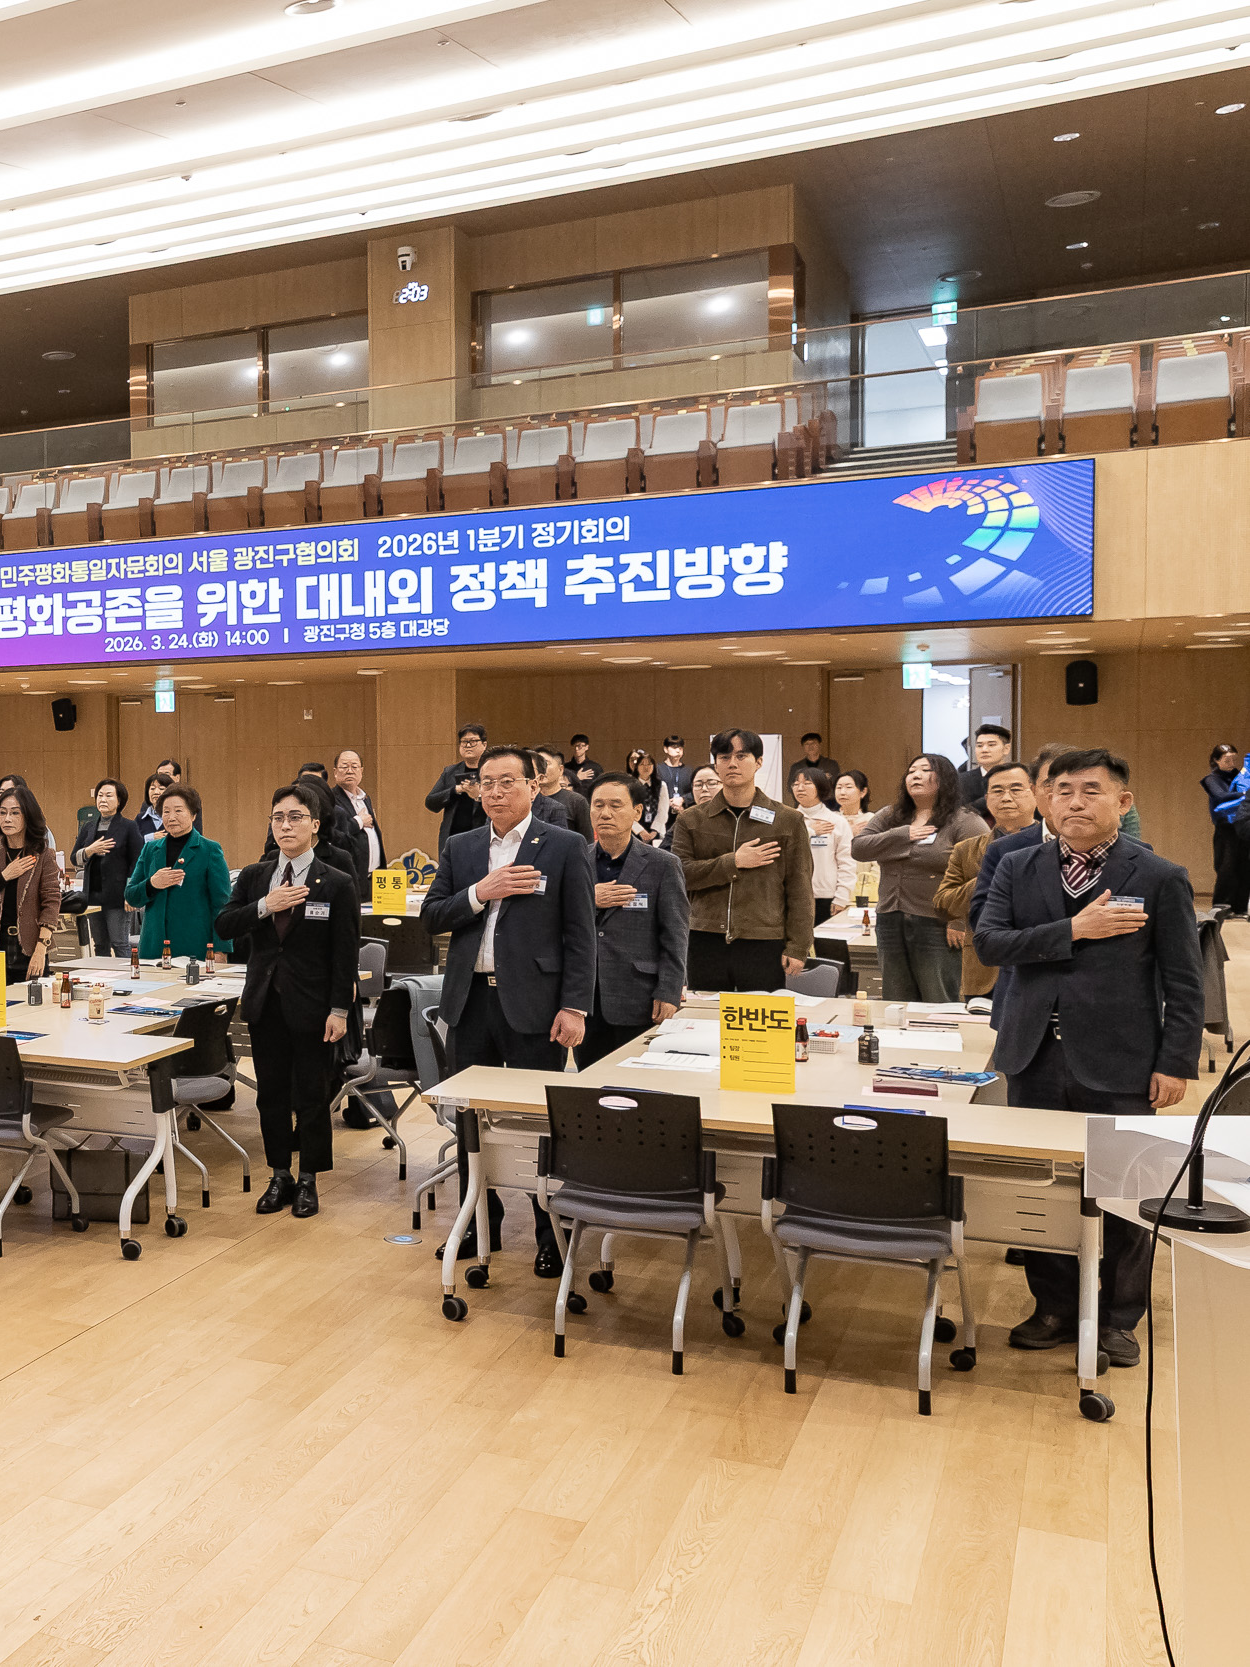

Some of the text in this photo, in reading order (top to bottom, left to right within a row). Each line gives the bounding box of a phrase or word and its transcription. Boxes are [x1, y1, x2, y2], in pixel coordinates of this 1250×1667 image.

[0, 515, 630, 588] 민주평화통일자문회의 서울 광진구협의회 2026년 1분기 정기회의
[197, 577, 284, 627] 위한
[296, 569, 433, 620] 대내외
[449, 558, 548, 612] 정책
[565, 541, 788, 605] 추진방향
[104, 618, 450, 653] 2026. 3. 24.(화) 14:00 광진구청 5층 대강당
[721, 1006, 792, 1032] 한반도
